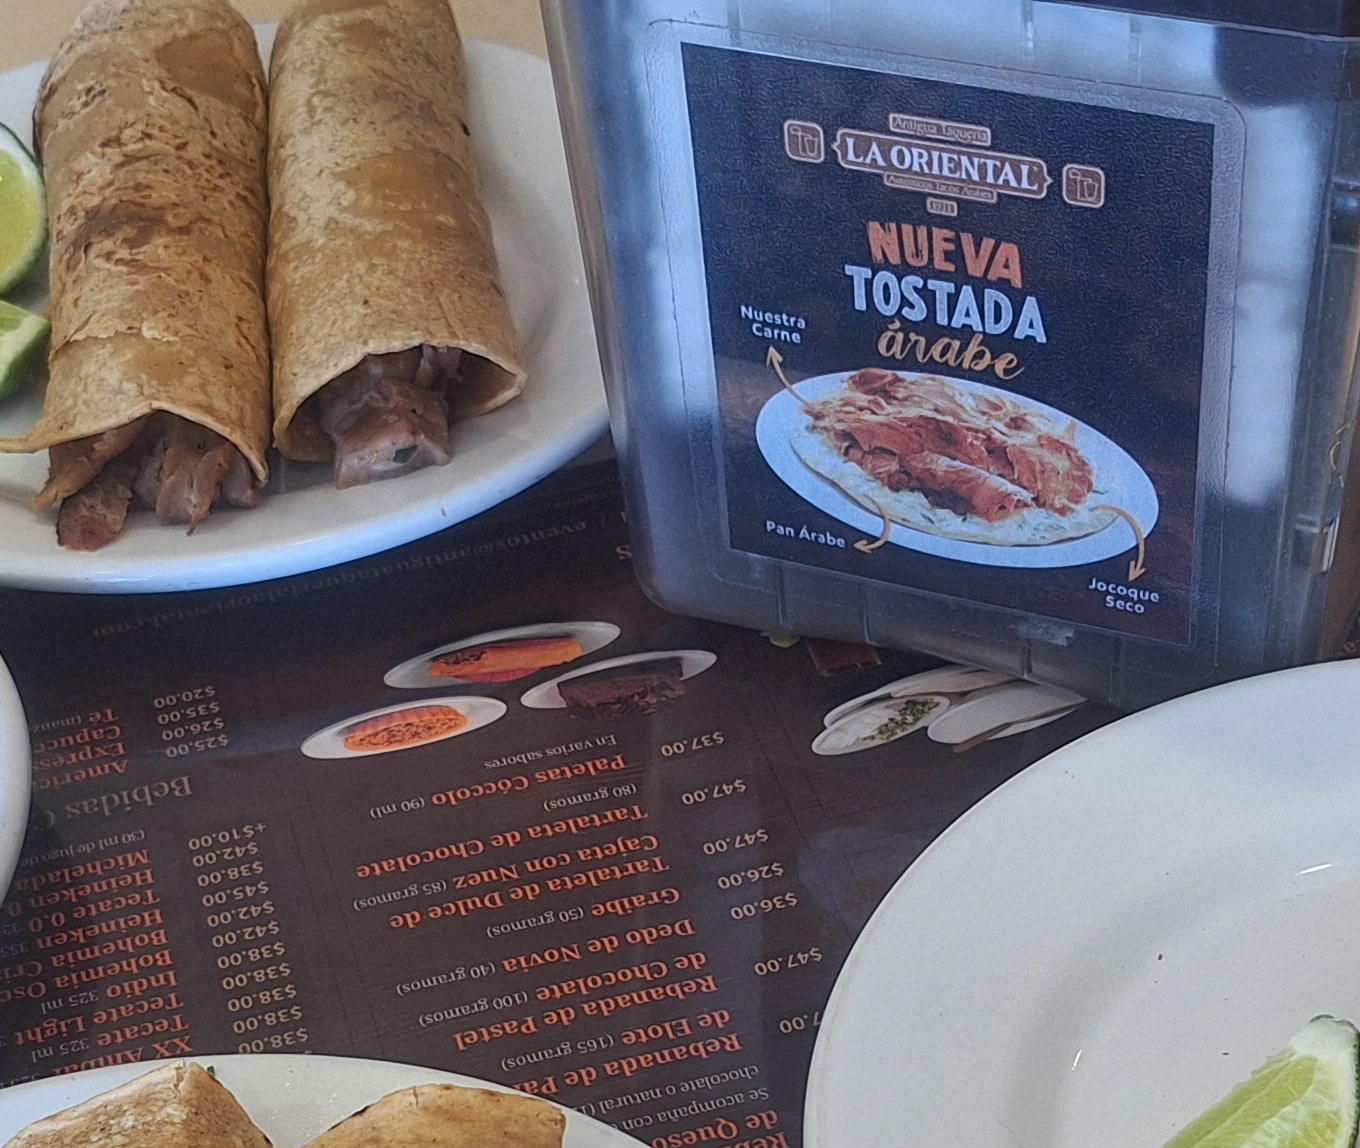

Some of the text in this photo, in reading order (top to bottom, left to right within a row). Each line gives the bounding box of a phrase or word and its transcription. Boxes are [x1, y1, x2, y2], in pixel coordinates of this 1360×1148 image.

[846, 137, 1039, 190] LA ORIENTAL
[867, 221, 1023, 288] NUEVA
[741, 305, 806, 329] Nuestra
[844, 265, 1047, 343] TOSTADA
[752, 322, 801, 345] Carne
[877, 320, 1024, 379] árabe
[766, 519, 846, 548] Pan Árabe
[1088, 576, 1159, 604] Jocoque
[1105, 594, 1144, 614] Seco
[154, 686, 215, 708] $20.00
[89, 709, 118, 725] Té
[158, 702, 220, 724] $35.00
[162, 718, 224, 740] $26.00
[165, 734, 228, 758] $25.00
[484, 735, 616, 769] En varios sabores
[661, 732, 724, 756] $37.00
[30, 759, 128, 788] Americ
[370, 755, 626, 818] Paletas Cóccolo (90 ml)
[66, 776, 192, 817] Bebidas
[543, 783, 636, 812] (80 gramos)
[682, 780, 746, 804] $47.00
[77, 842, 96, 853] de
[99, 836, 119, 850] ml
[122, 829, 145, 843] (30
[189, 823, 266, 850] +$10.00
[357, 805, 648, 877] Tartaleta de Chocolate
[703, 829, 768, 854] $47.00
[193, 842, 258, 867] $42.00
[14, 850, 153, 891] Michelada
[197, 861, 263, 886] $38.00
[354, 836, 658, 911] Cajeta con Nuez (85 gramos)
[718, 863, 783, 889] $26.00
[30, 868, 156, 908] Heineken
[202, 881, 269, 907] $45.00
[391, 849, 669, 928] Tartaleta de Dulce de
[74, 889, 160, 917] Tecate
[207, 901, 274, 927] $42.00
[487, 888, 679, 938] Graibe (50 gramos)
[731, 892, 797, 919] $36.00
[29, 912, 66, 932] 0.0
[39, 909, 164, 947] Heineken
[212, 921, 279, 947] $42.00
[52, 929, 168, 967] Bohemia
[217, 942, 285, 968] $38.00
[396, 920, 695, 996] Dedo de Novia (40 gramos)
[754, 947, 822, 975] $47.00
[56, 949, 173, 987] Bohemia
[222, 963, 291, 989] $38.00
[41, 971, 177, 1014] Indio 325 ml
[228, 984, 296, 1011] $38.00
[419, 953, 706, 1027] de Chocolate (100 gramos)
[94, 993, 184, 1023] Tecate
[233, 1006, 302, 1033] $38.00
[454, 976, 718, 1050] Rebanada de Pastel
[16, 1016, 86, 1045] Light
[31, 1015, 188, 1063] Tecate 325 ml
[238, 1028, 309, 1056] $38.00
[501, 1010, 730, 1071] de Elote (165 gramos)
[152, 1036, 194, 1060] XX
[604, 1034, 742, 1076] Rebanada
[565, 1067, 597, 1086] de
[665, 1085, 676, 1095] o
[680, 1066, 759, 1092] chocolate
[599, 1088, 662, 1114] natural
[749, 1087, 769, 1100] Se
[657, 1093, 745, 1122] acompaña
[745, 1110, 778, 1129] de
[622, 1116, 653, 1133] con
